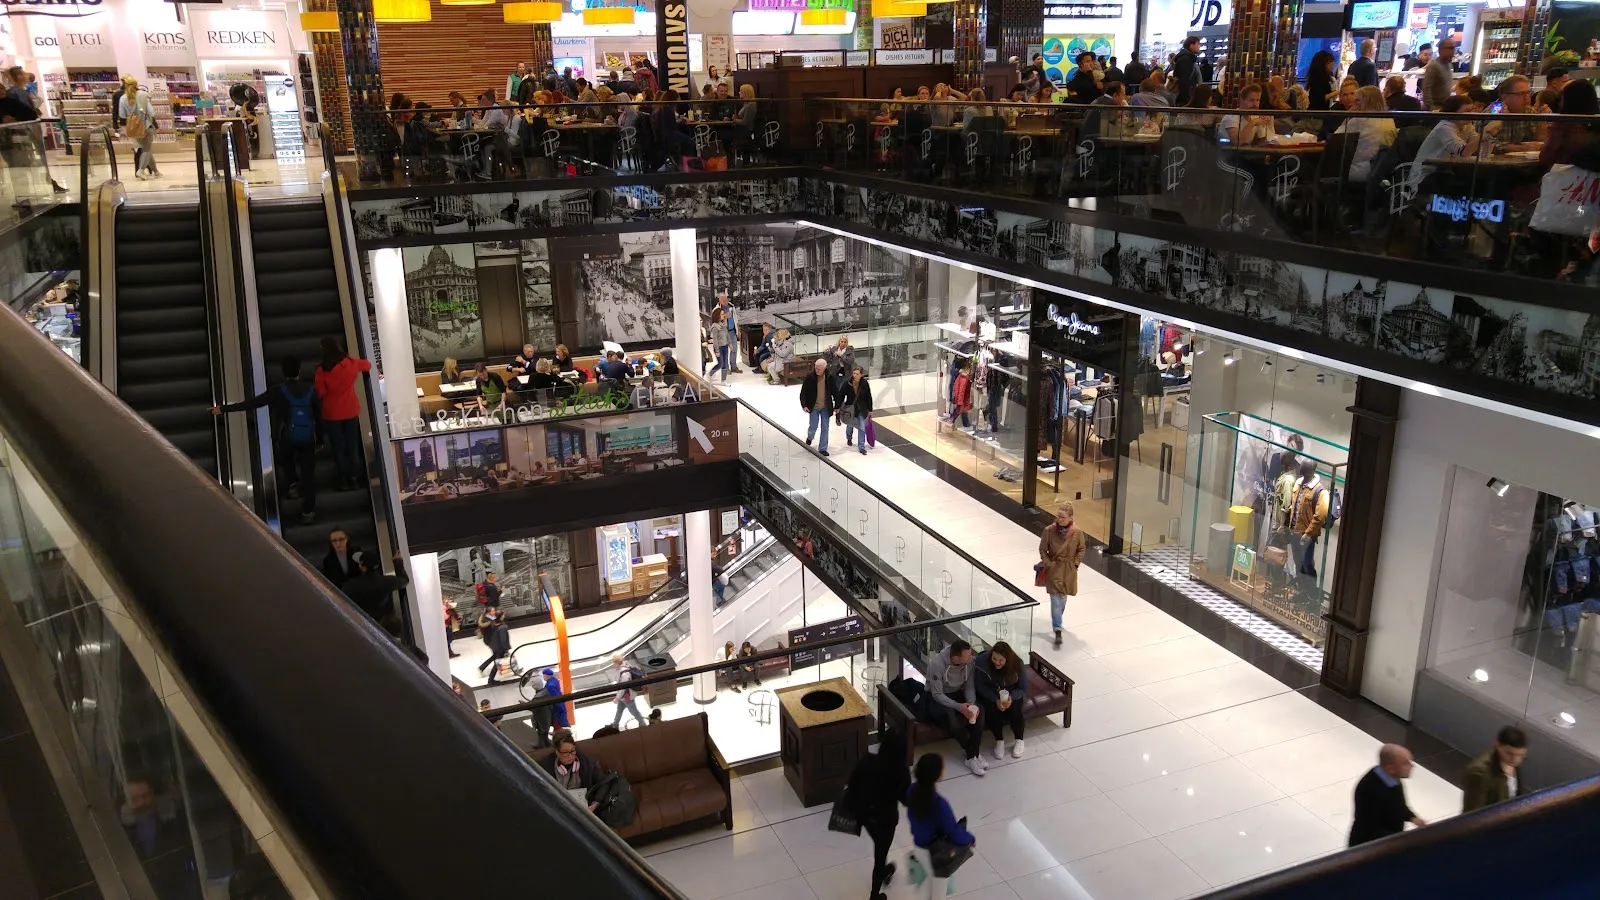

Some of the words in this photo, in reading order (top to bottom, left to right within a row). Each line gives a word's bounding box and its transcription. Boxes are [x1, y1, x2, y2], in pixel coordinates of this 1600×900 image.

[1190, 0, 1222, 26] JD
[66, 33, 102, 46] TIGI
[207, 31, 276, 44] REDKEN
[883, 30, 909, 44] DICH
[664, 4, 689, 94] SATURN
[812, 55, 834, 63] RETURN
[1047, 303, 1071, 330] Pepe
[1068, 312, 1101, 336] Jeans
[1063, 333, 1086, 345] LONDON
[436, 409, 453, 432] &
[711, 430, 721, 438] 20
